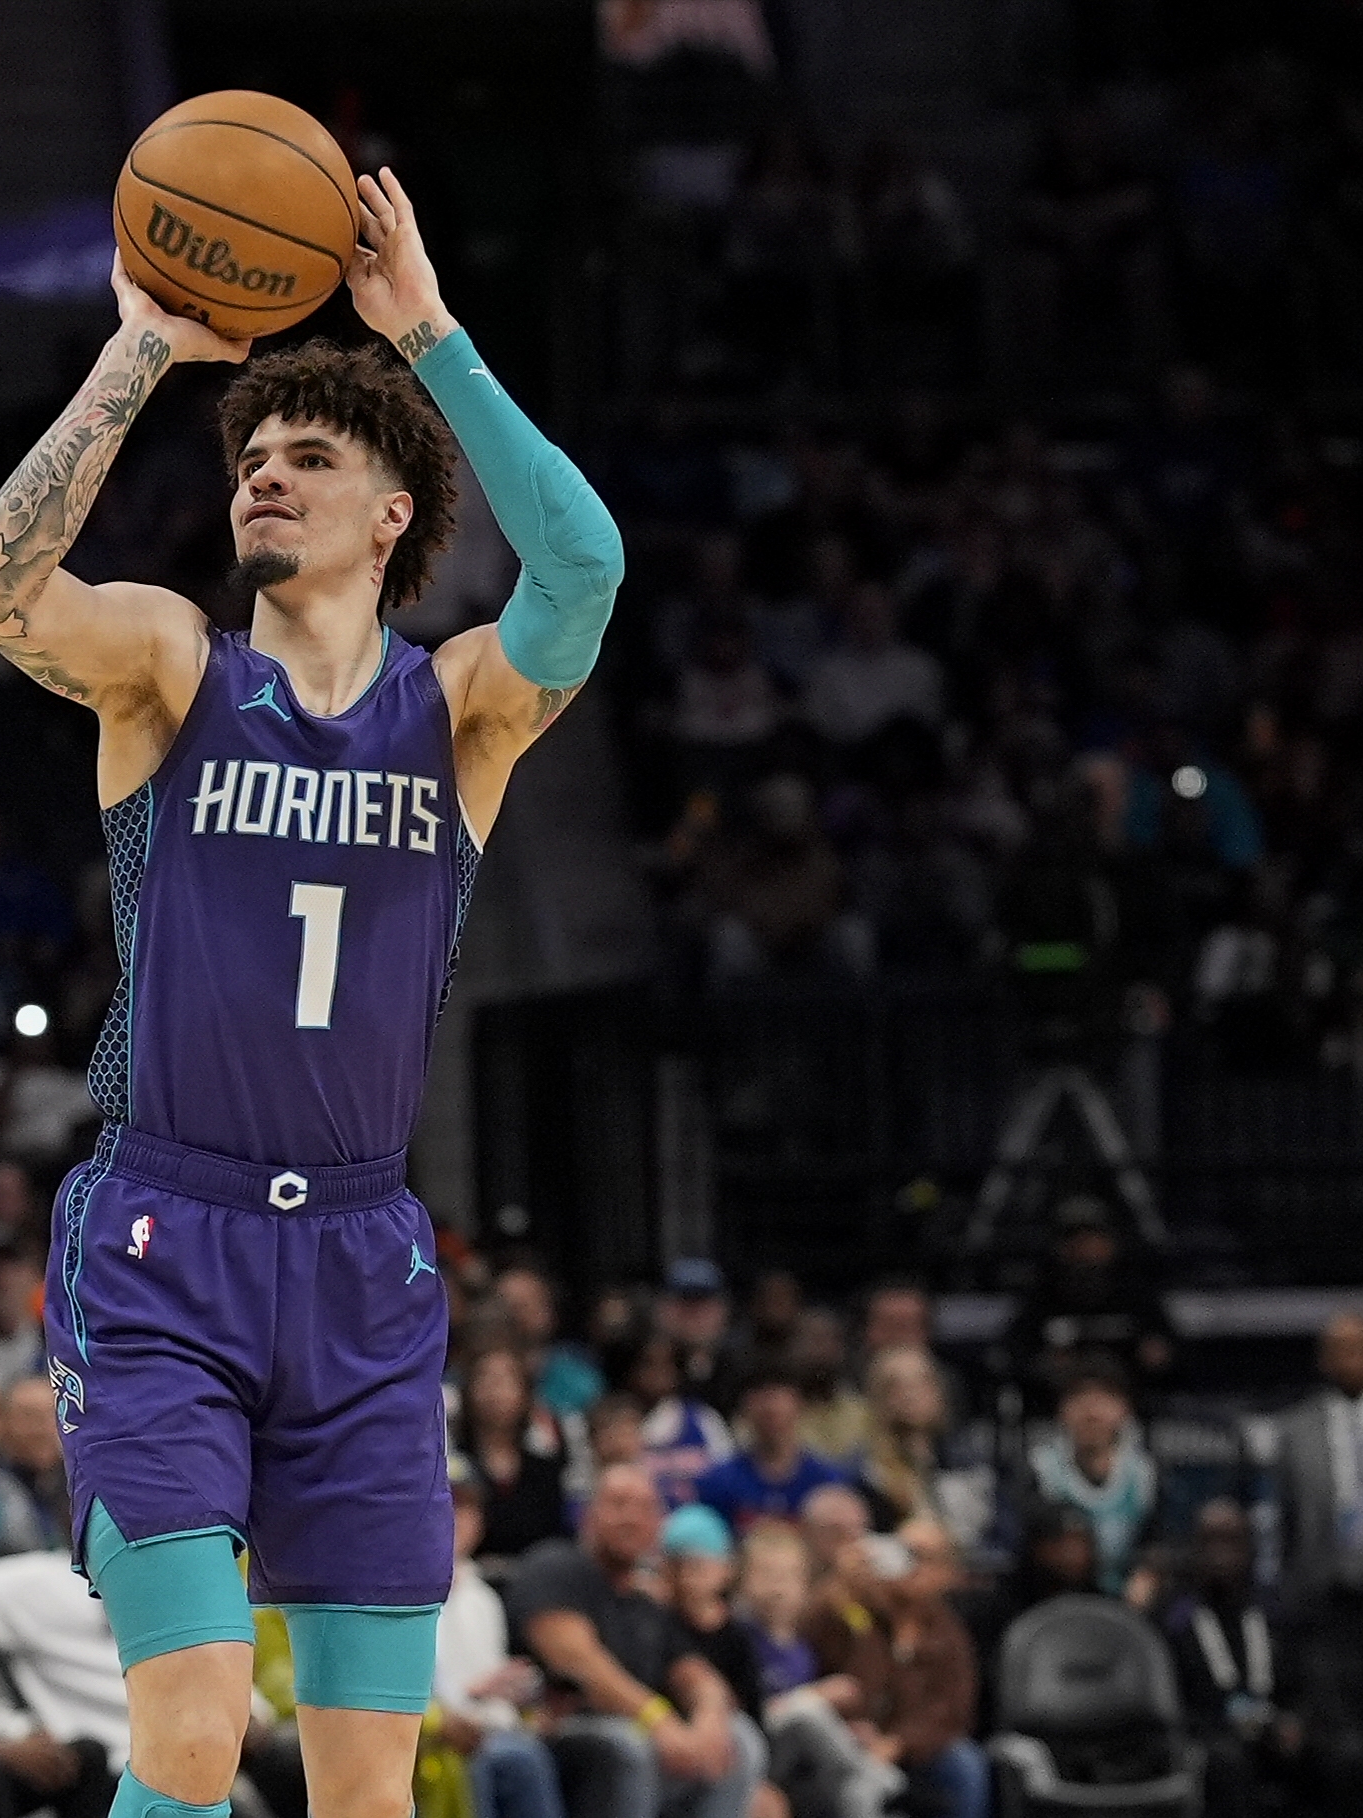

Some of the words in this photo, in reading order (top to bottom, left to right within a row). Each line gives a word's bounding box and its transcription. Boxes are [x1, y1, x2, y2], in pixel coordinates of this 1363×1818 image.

[146, 200, 297, 297] Wilson
[187, 759, 445, 855] HORNETS
[288, 880, 346, 1030] 1
